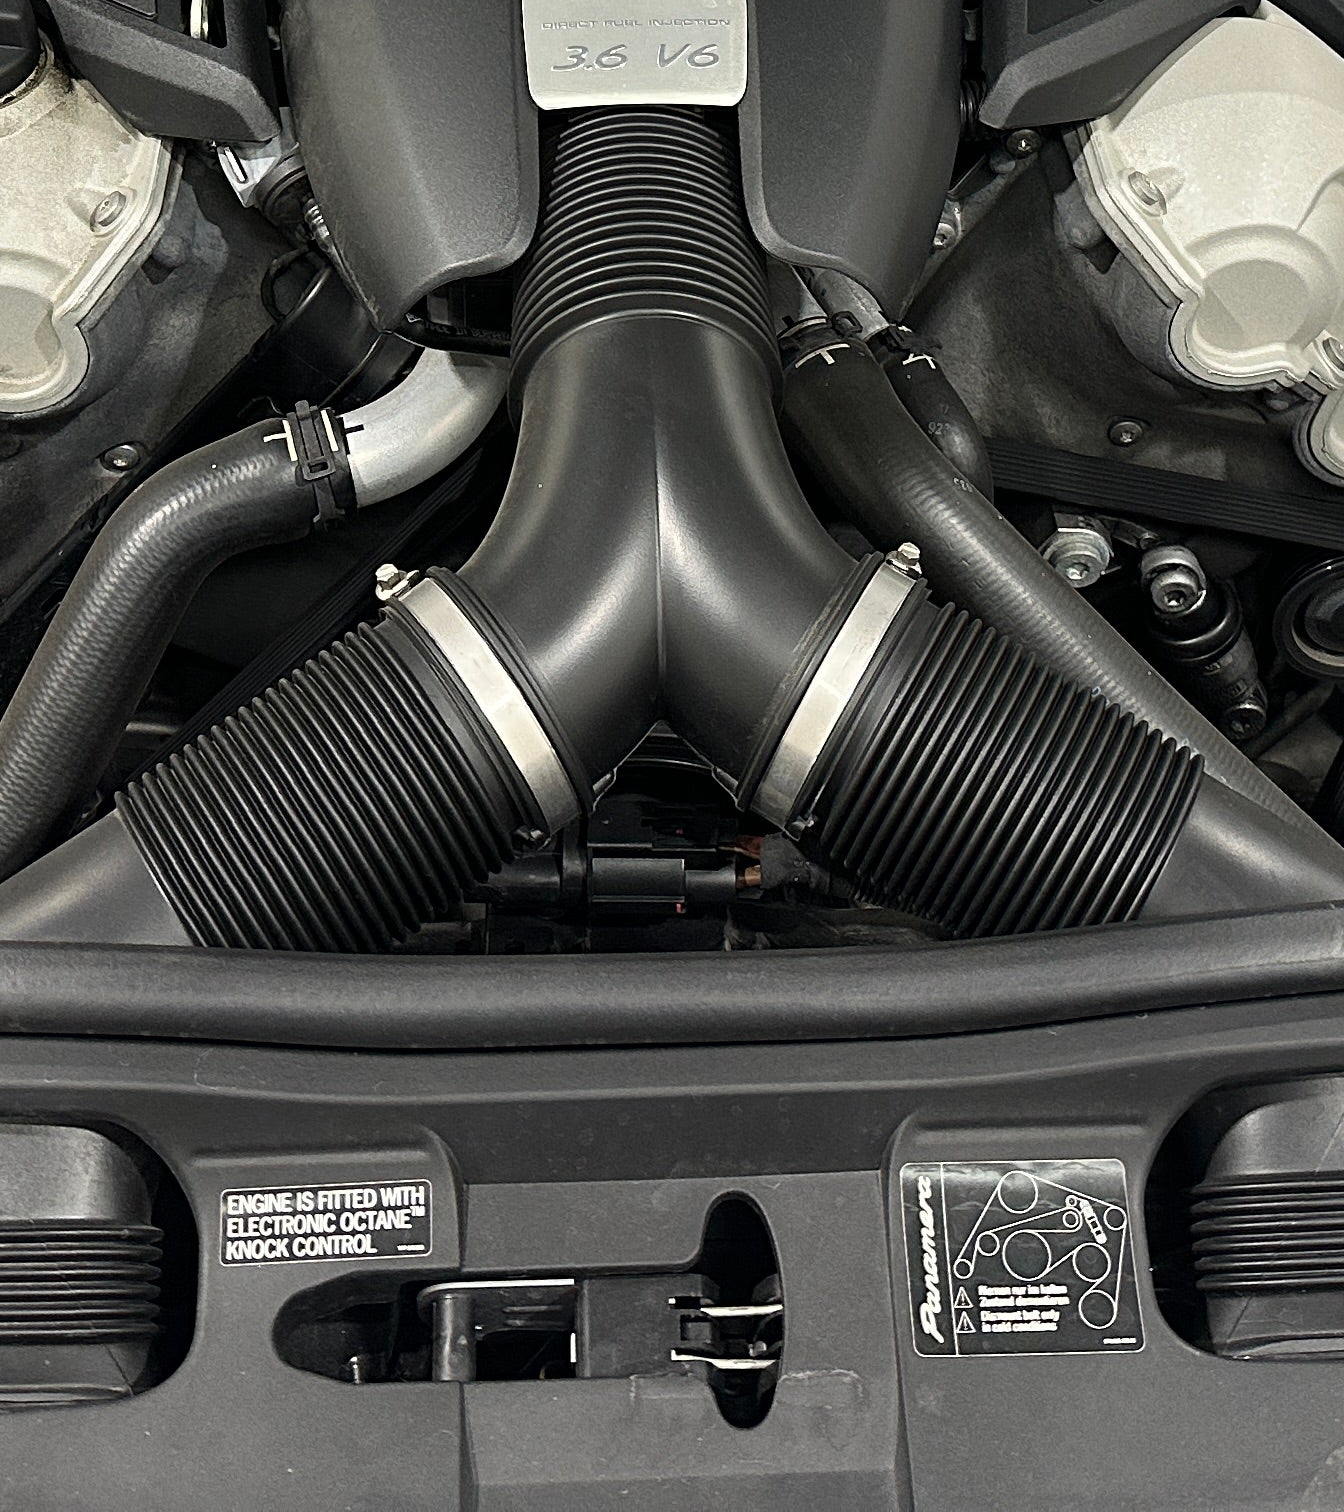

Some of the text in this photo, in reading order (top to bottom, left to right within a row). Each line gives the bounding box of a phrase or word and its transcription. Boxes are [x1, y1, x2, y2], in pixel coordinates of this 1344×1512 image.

[551, 43, 720, 72] 3.6 V6
[226, 1186, 425, 1215] ENGINE IS FITTED WITH
[226, 1214, 337, 1237] ELECTRONIC
[226, 1234, 377, 1260] KNOCK CONTROL
[917, 1175, 945, 1344] Panamera
